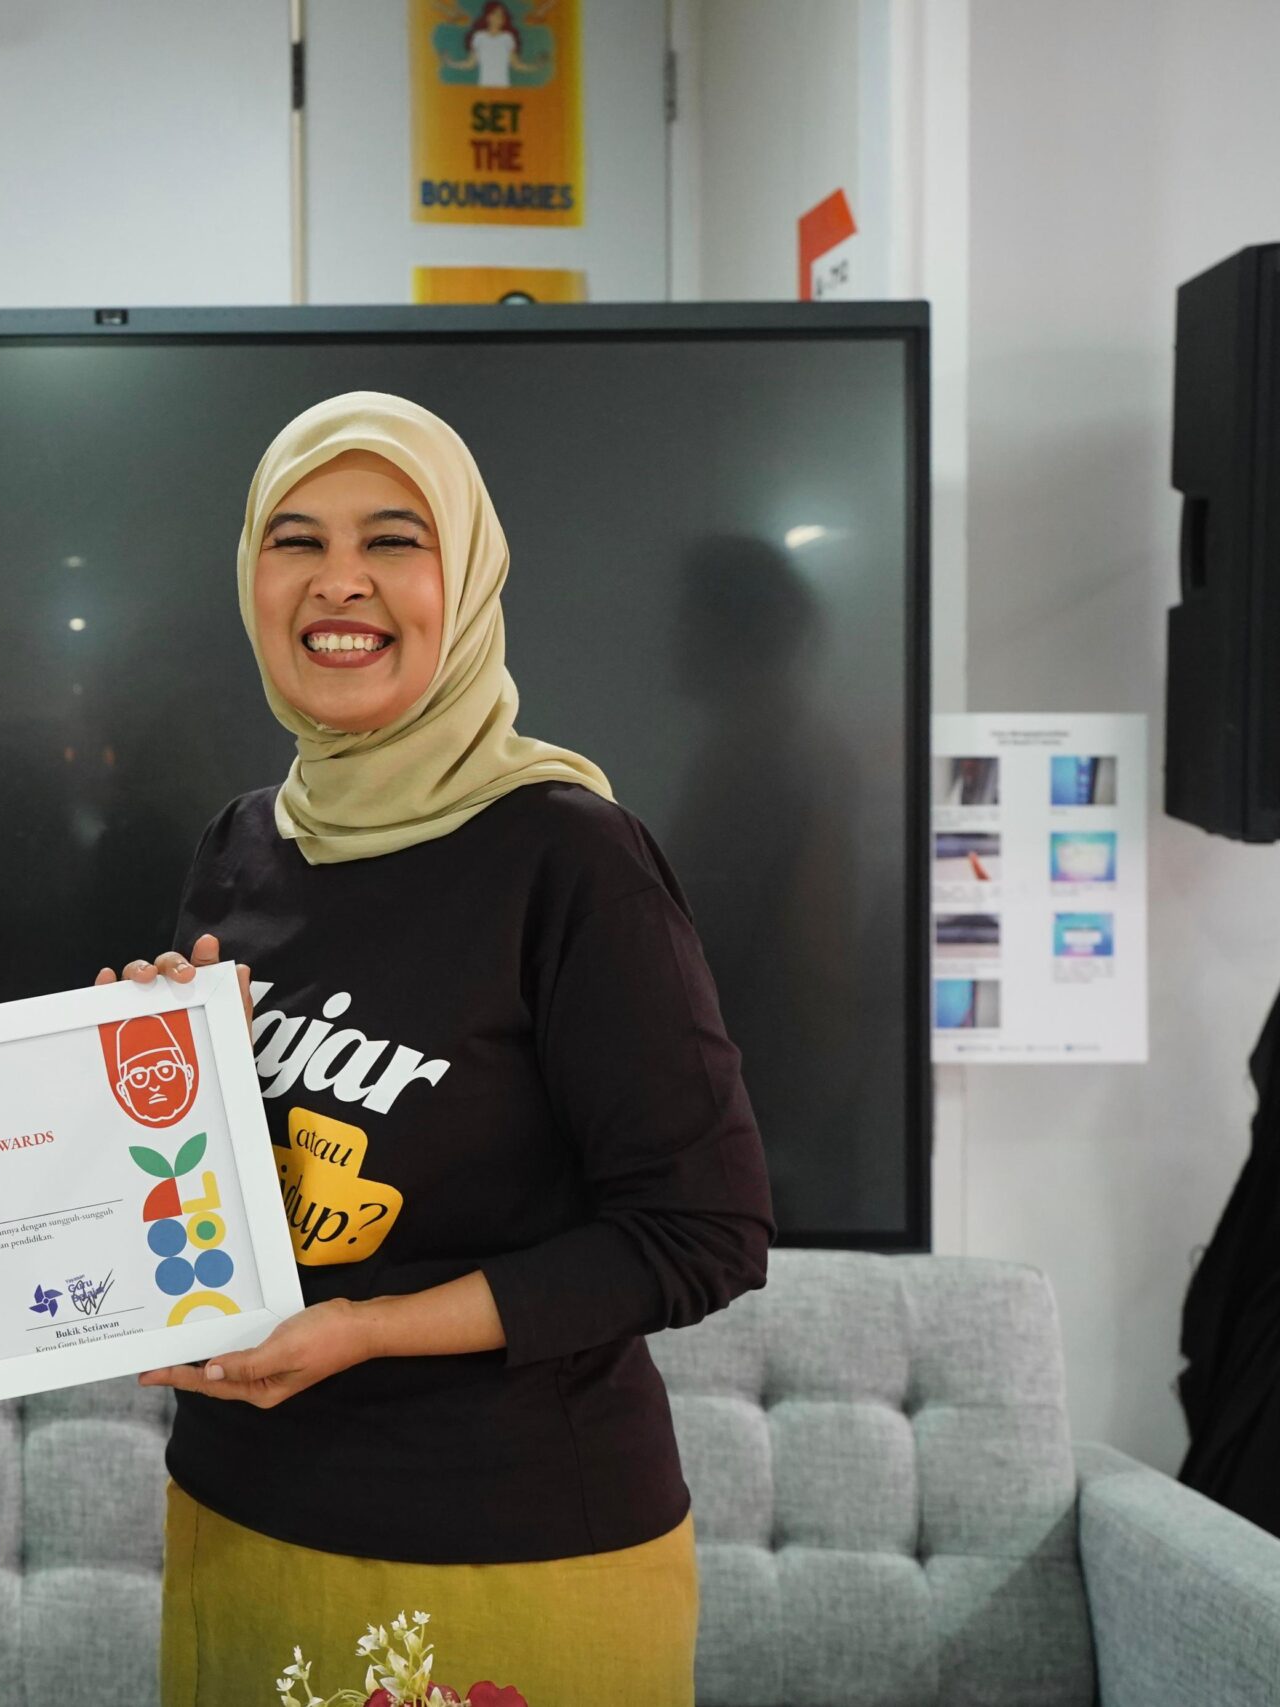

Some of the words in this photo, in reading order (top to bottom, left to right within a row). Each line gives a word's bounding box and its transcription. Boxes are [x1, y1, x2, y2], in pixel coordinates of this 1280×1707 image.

[471, 102, 522, 133] SET
[471, 139, 523, 172] THE
[420, 180, 574, 210] BOUNDARIES
[249, 980, 451, 1115] ajar
[297, 1128, 353, 1167] atau
[20, 1220, 48, 1233] dengan
[48, 1207, 114, 1227] sungguh-sungguh
[11, 1233, 55, 1249] pendidikan.
[55, 1327, 81, 1339] Bukik
[82, 1321, 120, 1334] Setiawan
